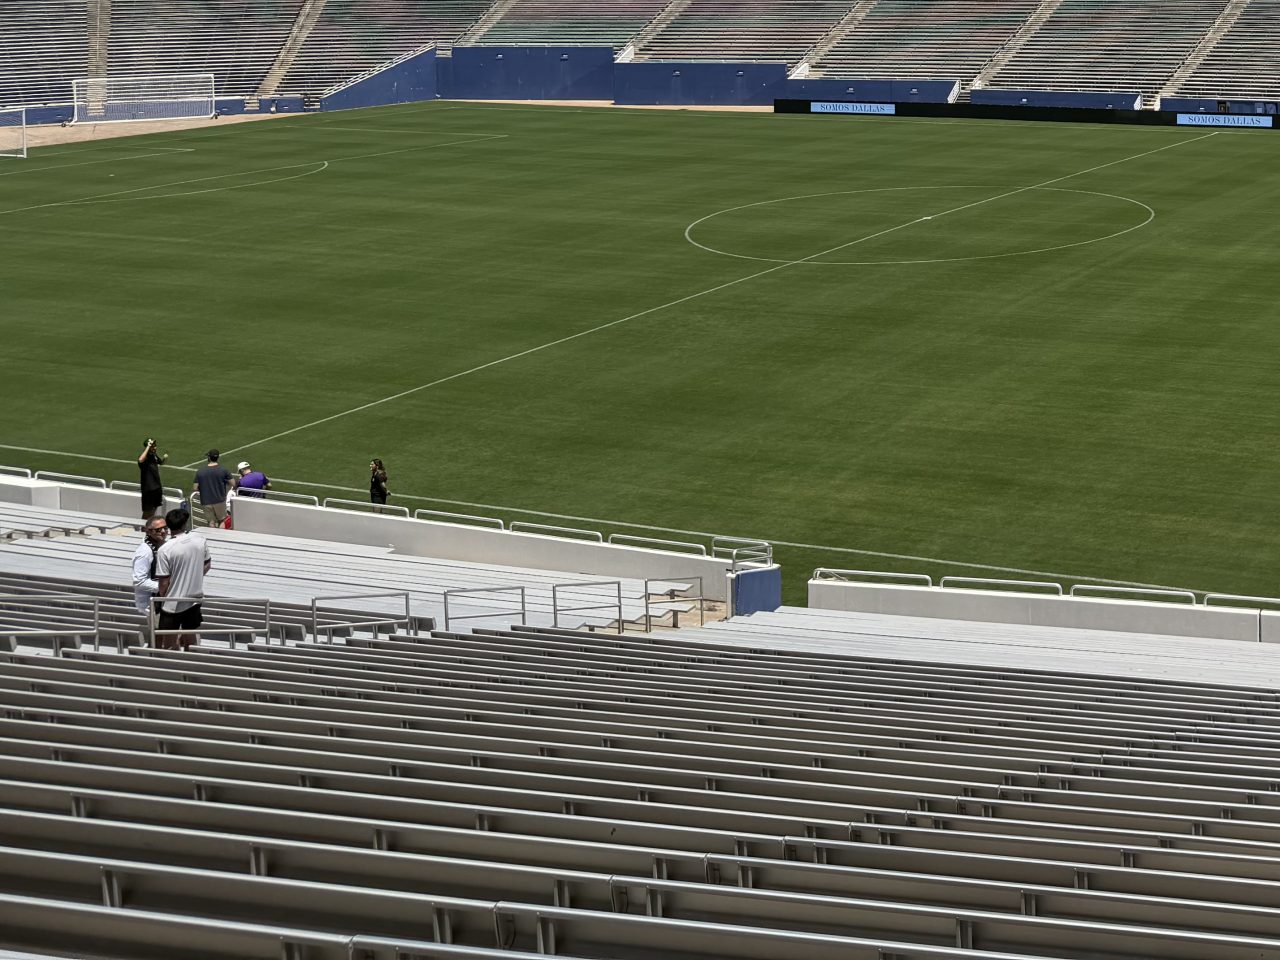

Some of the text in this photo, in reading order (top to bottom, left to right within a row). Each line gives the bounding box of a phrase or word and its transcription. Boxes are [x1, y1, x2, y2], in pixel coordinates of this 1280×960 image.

[820, 103, 886, 113] SOMOS DALLAS
[1188, 115, 1261, 125] SOMOS DALLAS
